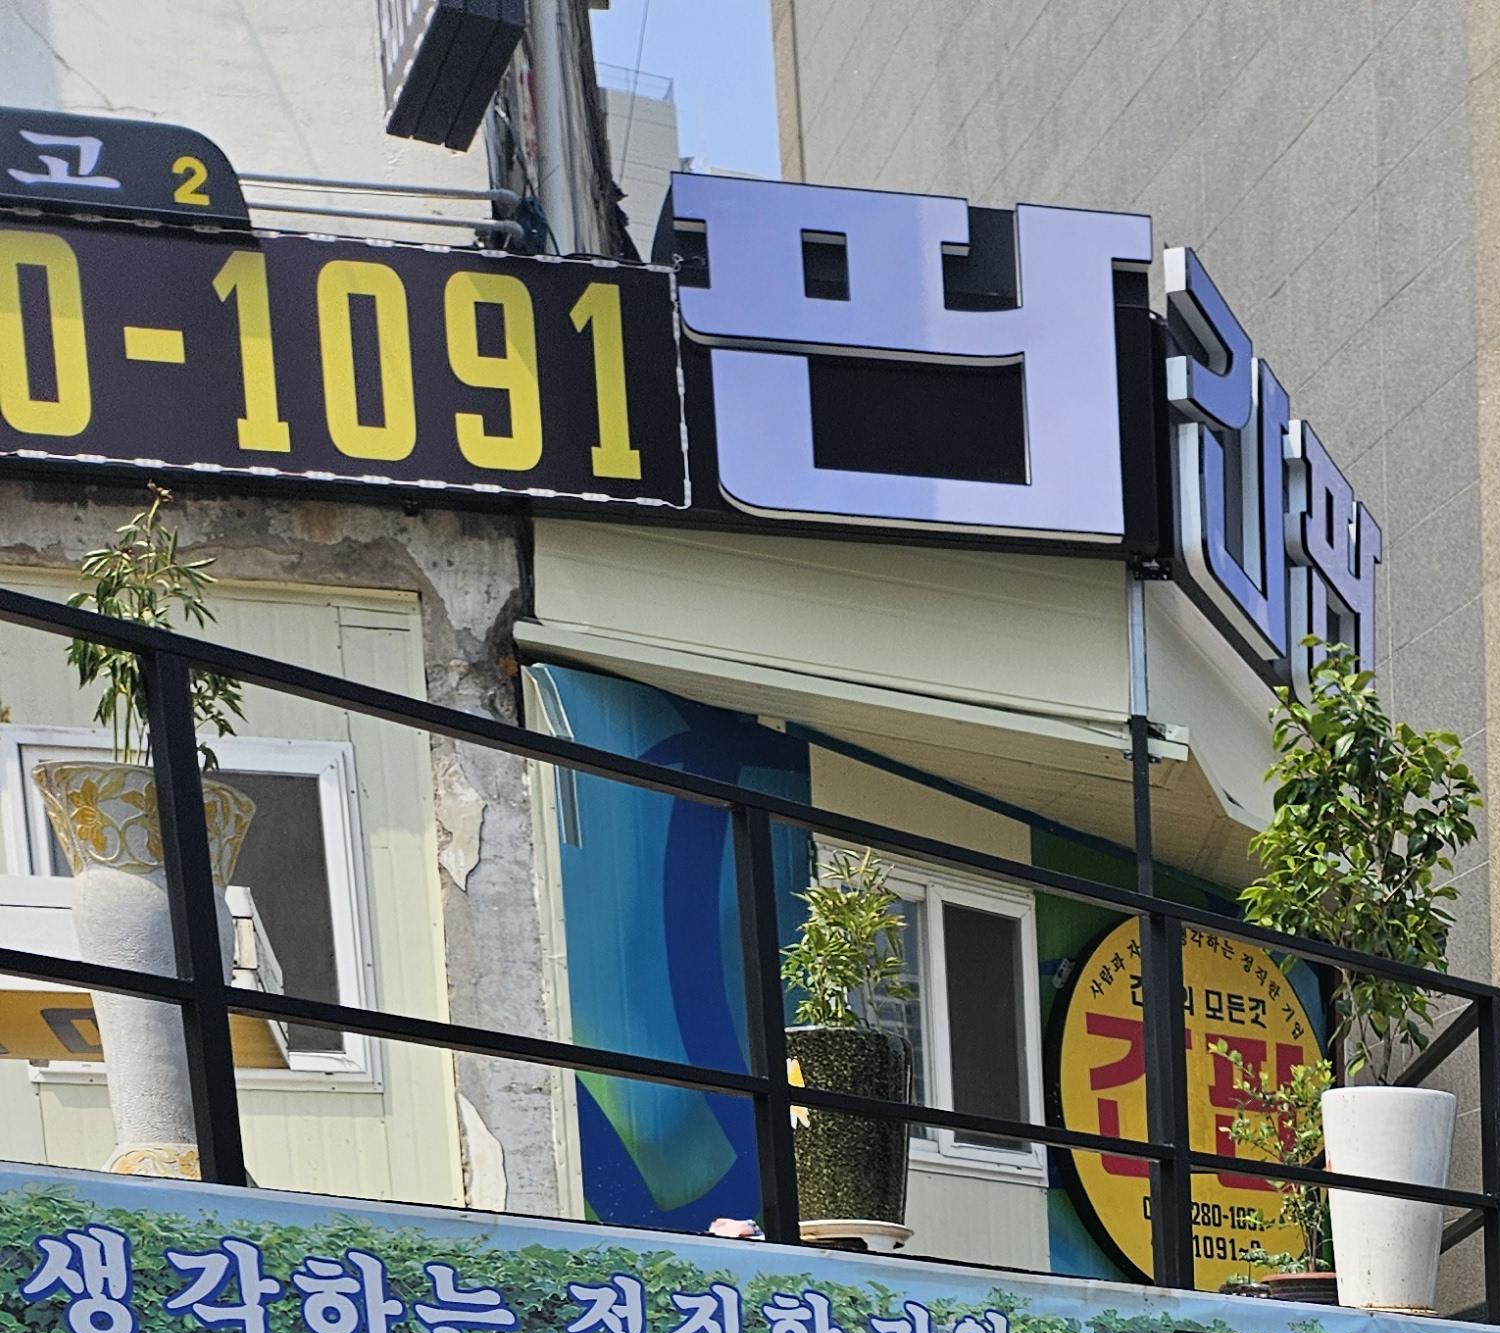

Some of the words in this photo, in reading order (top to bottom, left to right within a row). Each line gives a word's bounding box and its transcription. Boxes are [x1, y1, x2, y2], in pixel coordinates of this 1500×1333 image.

[8, 130, 121, 189] 고
[171, 155, 210, 206] 2
[0, 231, 643, 482] 0-1091
[671, 172, 1153, 540] 판
[1164, 246, 1383, 695] 간판
[1089, 952, 1127, 1000] 사람과
[1204, 987, 1268, 1029] 모든것
[1240, 952, 1281, 1001] 정직한
[1281, 1003, 1305, 1041] 기업
